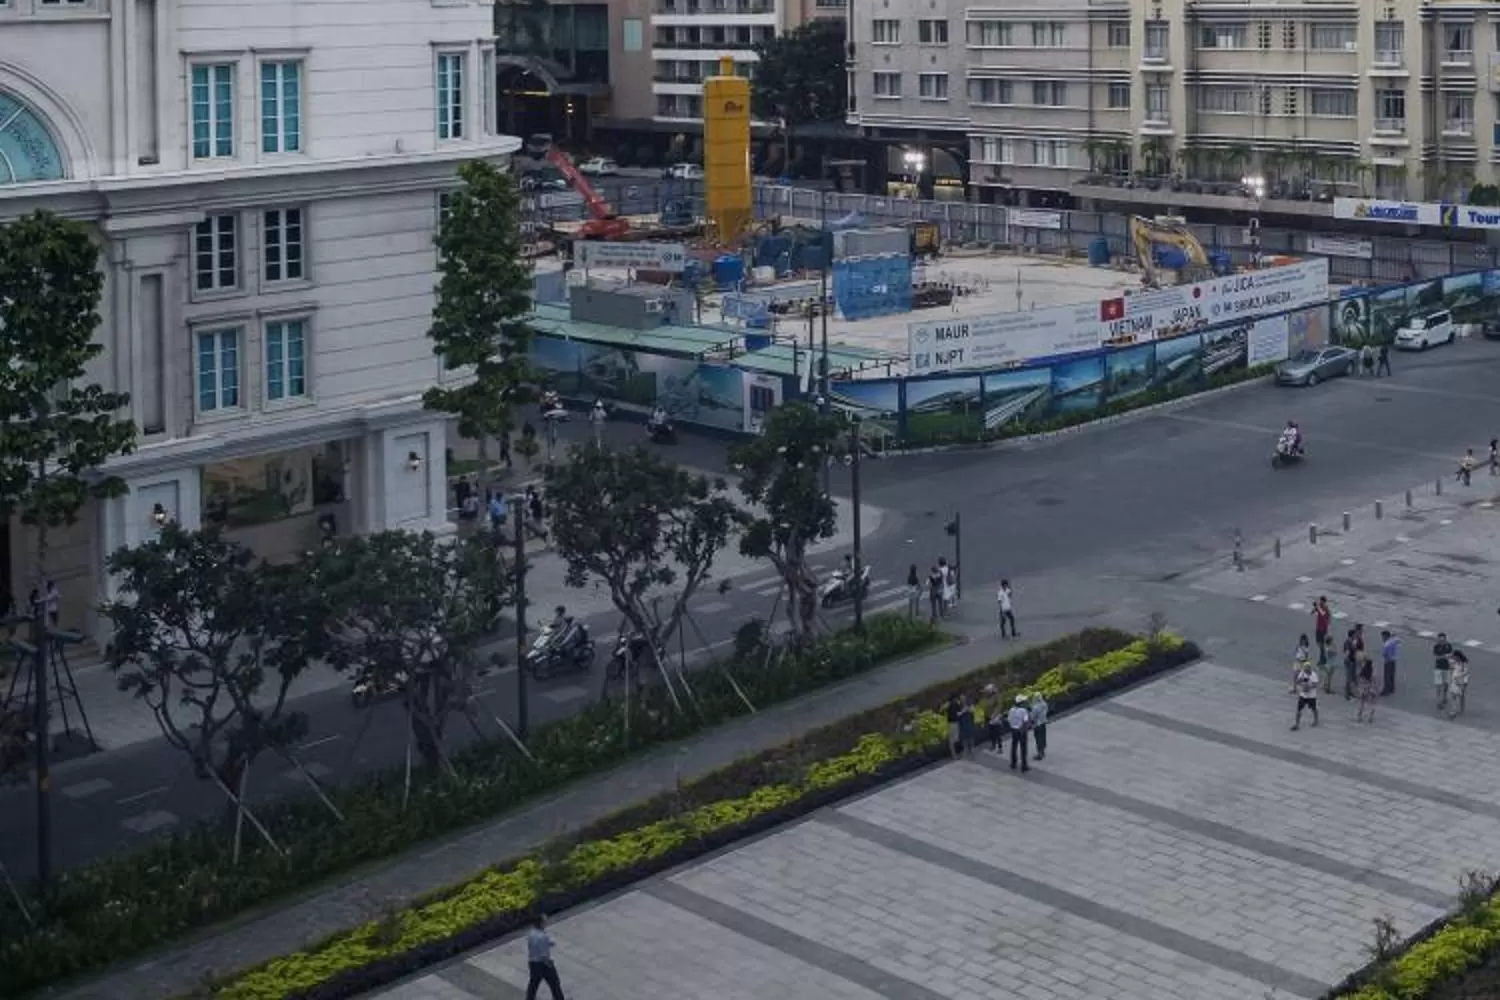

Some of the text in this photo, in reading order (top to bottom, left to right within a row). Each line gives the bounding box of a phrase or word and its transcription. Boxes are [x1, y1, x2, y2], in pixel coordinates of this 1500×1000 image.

[1109, 313, 1153, 337] VIETNAM
[1171, 304, 1201, 325] JAPAN
[935, 324, 969, 341] MAUR
[935, 350, 965, 365] NJPT
